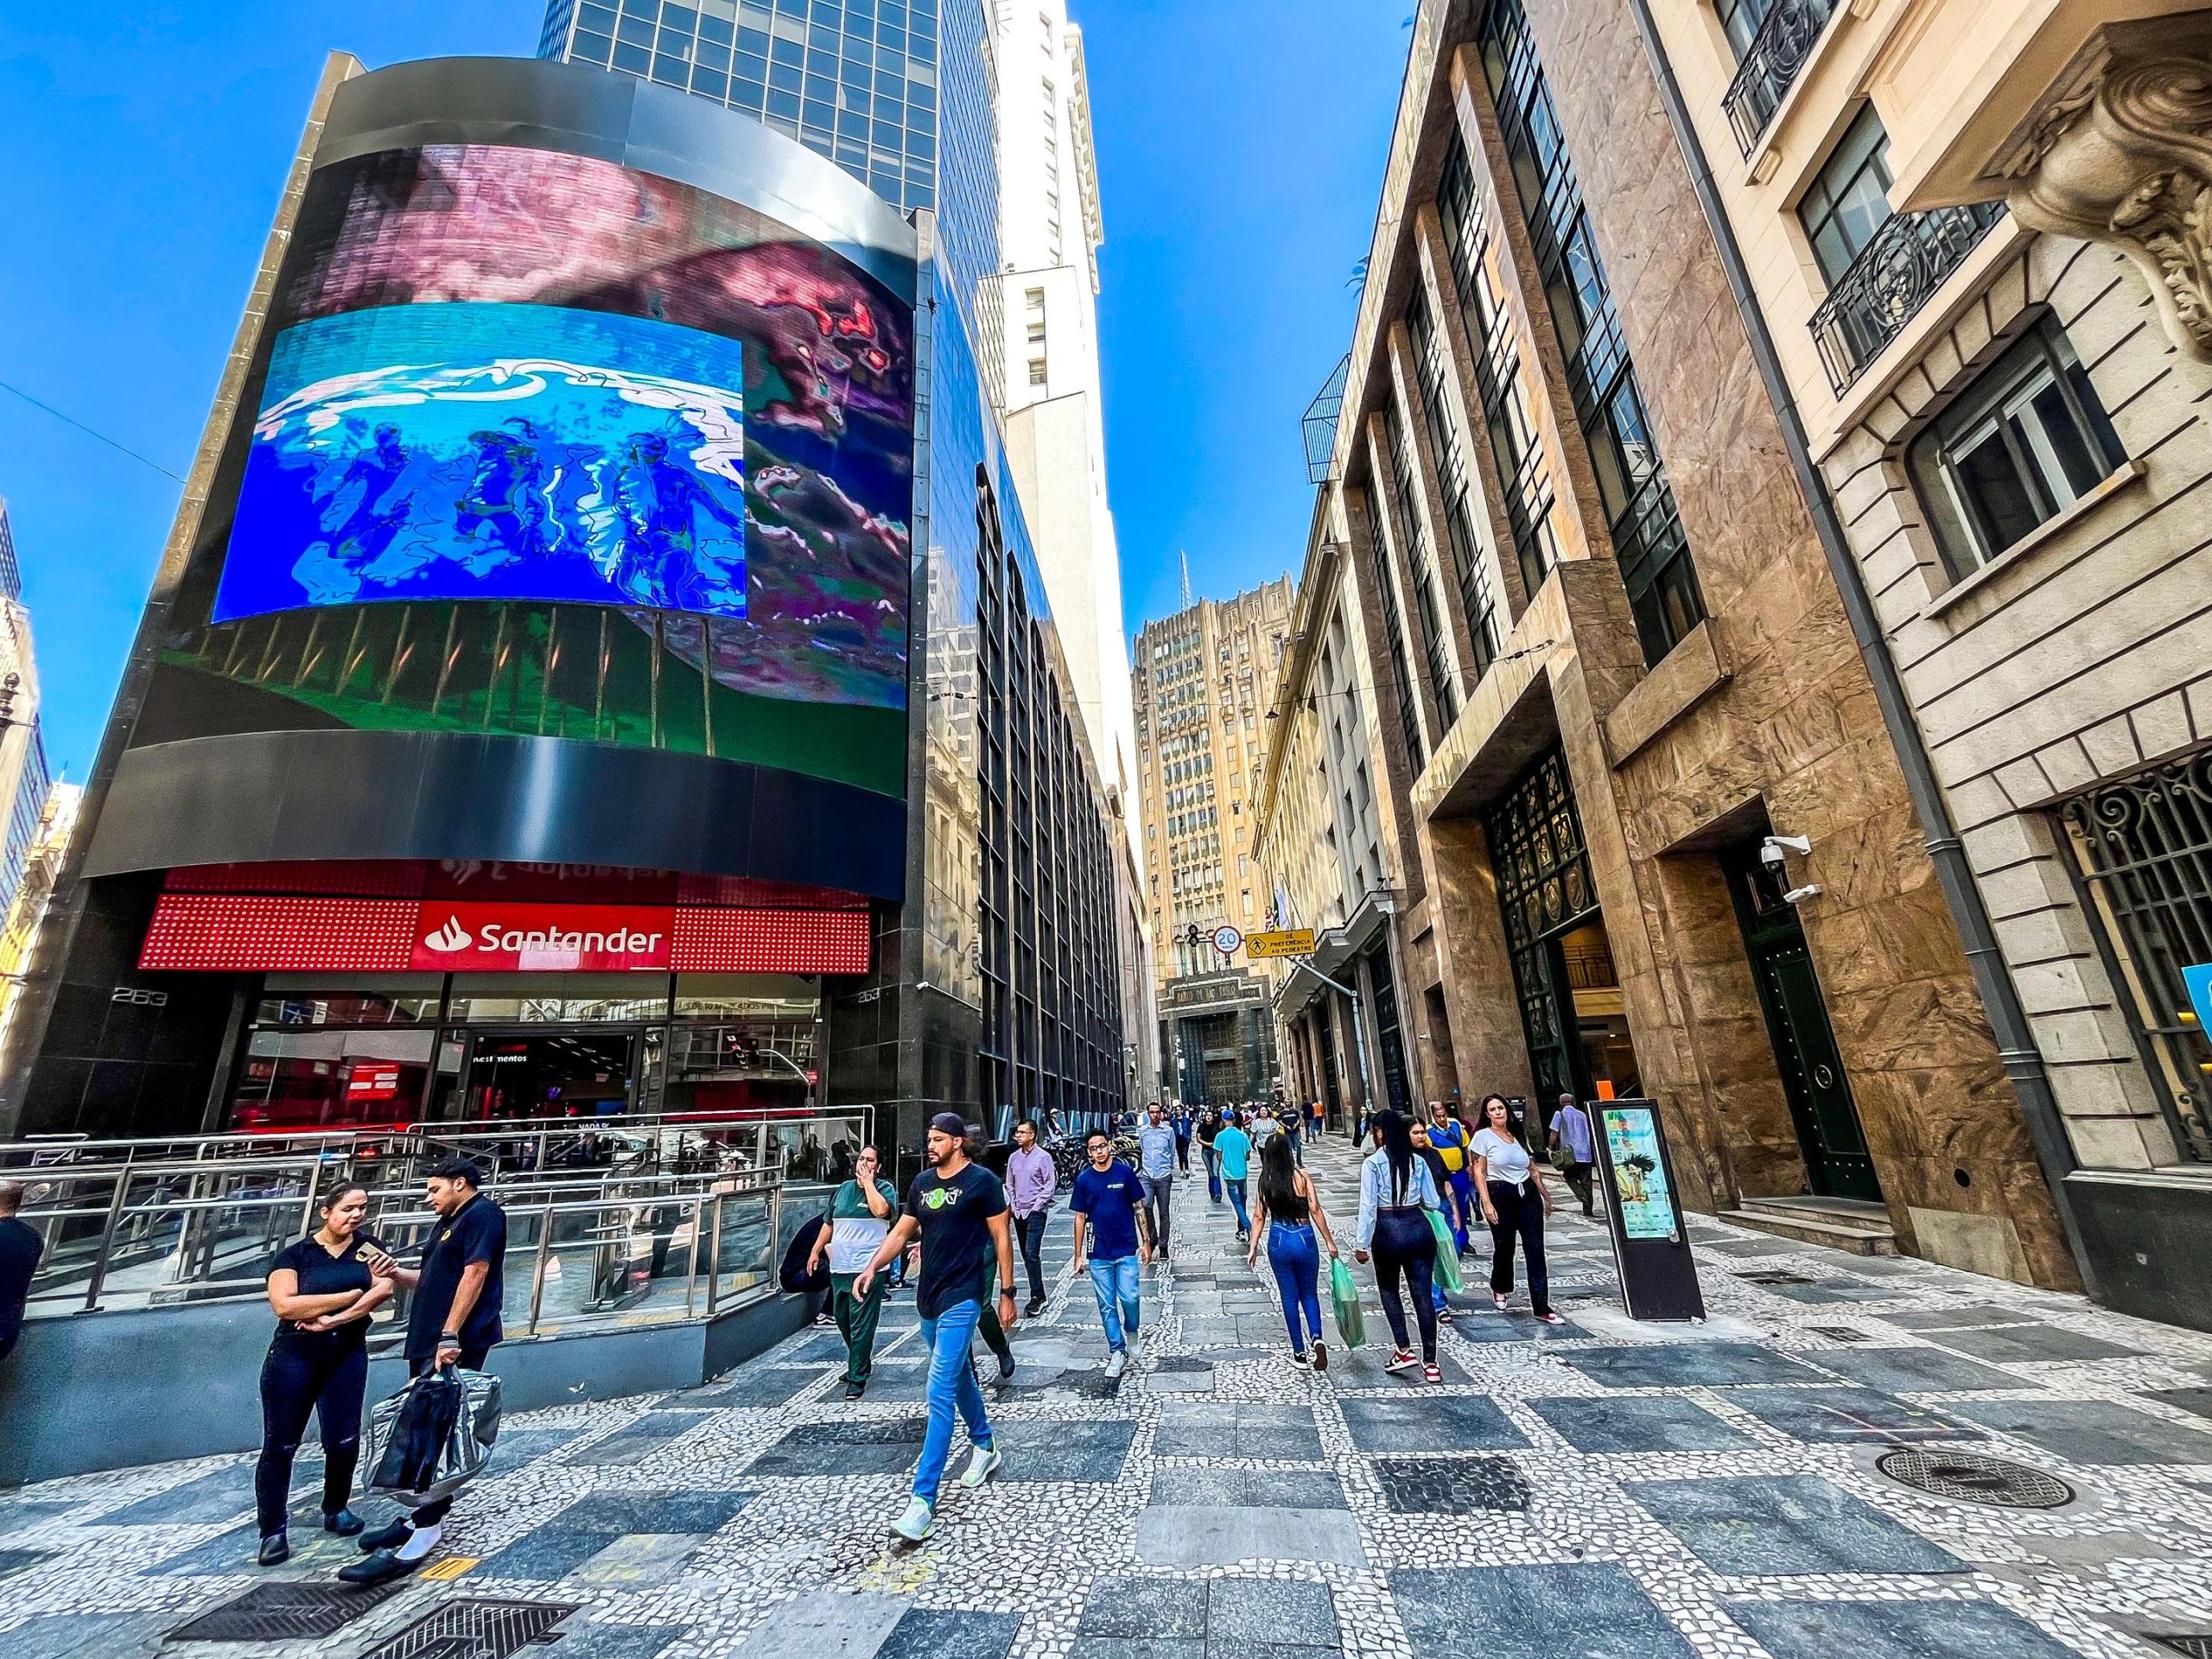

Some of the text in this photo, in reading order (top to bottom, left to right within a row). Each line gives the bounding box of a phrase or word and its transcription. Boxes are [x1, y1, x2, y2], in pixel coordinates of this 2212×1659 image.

[478, 924, 663, 953] Santander
[1218, 932, 1236, 944] 20
[111, 987, 168, 1006] 263
[858, 988, 880, 1003] 263
